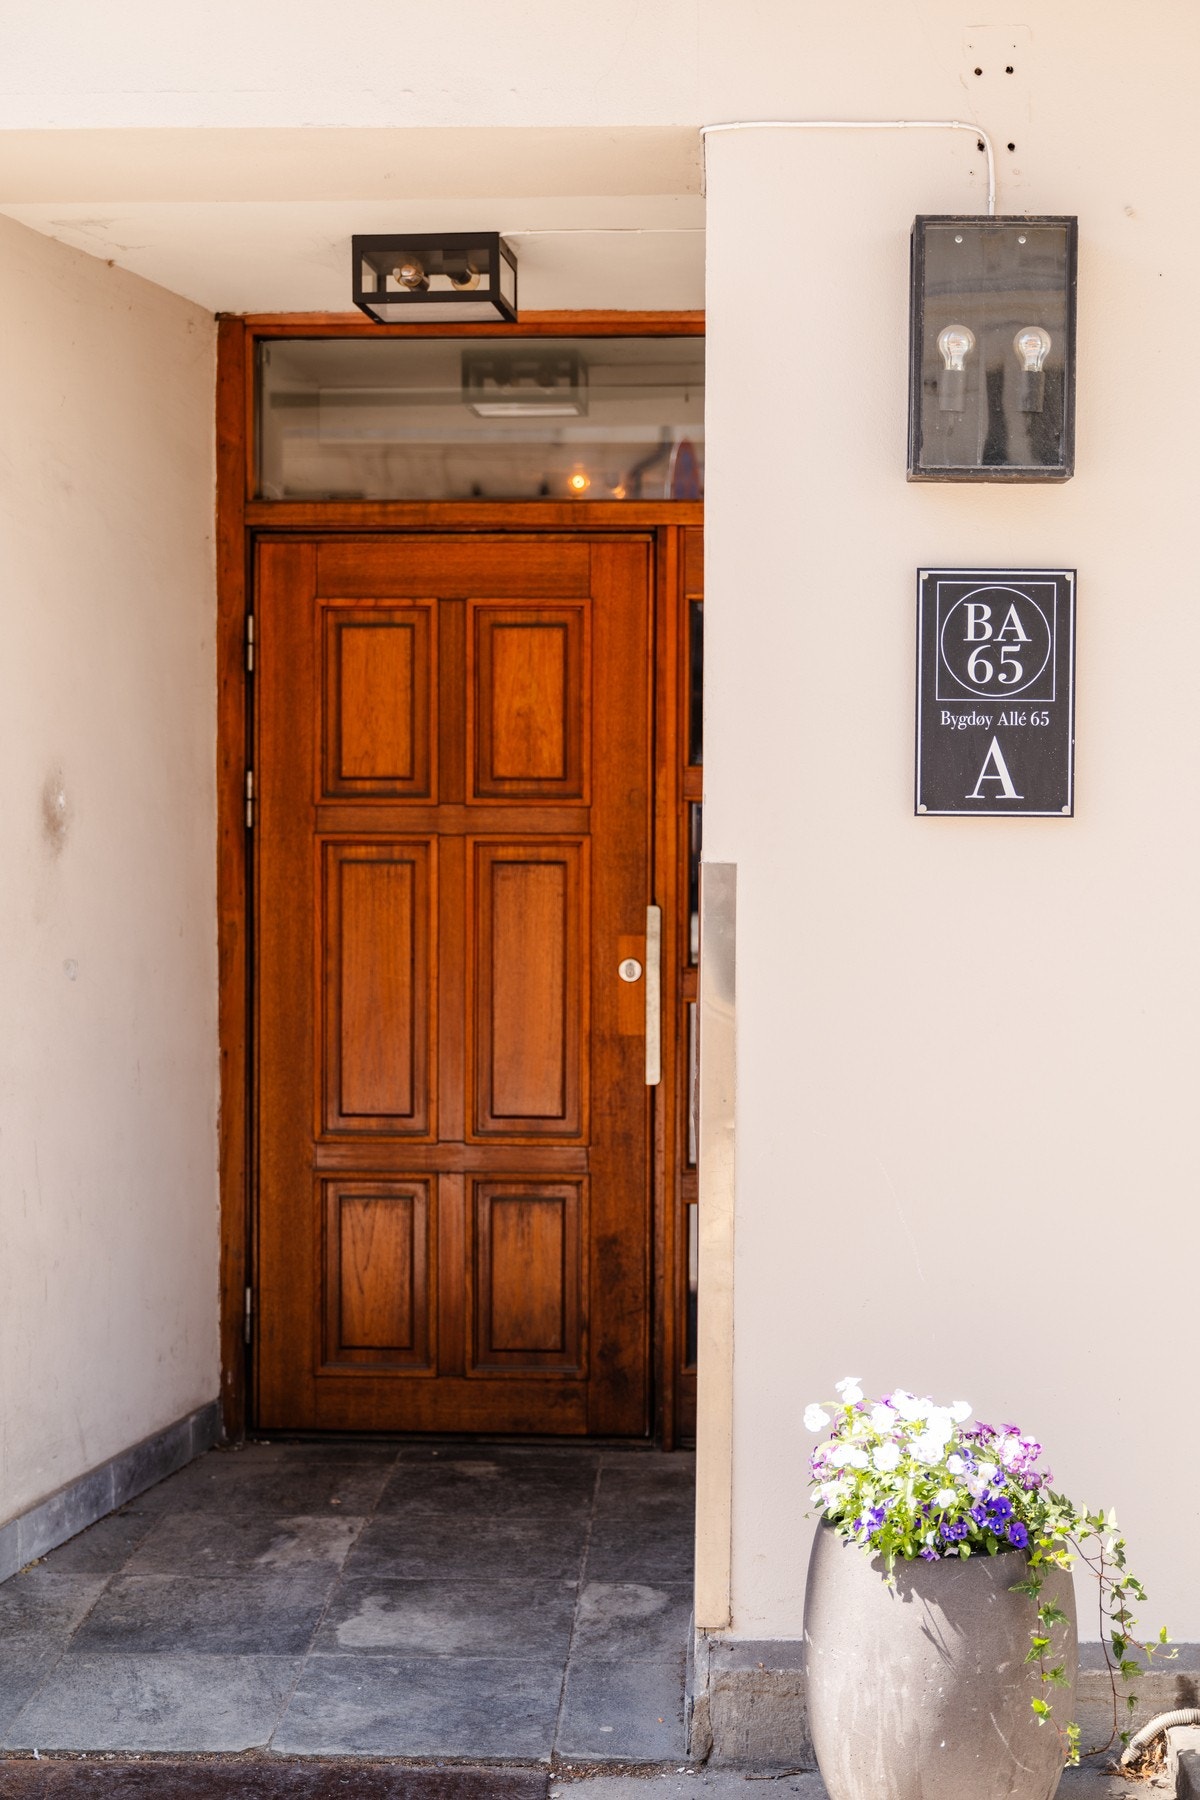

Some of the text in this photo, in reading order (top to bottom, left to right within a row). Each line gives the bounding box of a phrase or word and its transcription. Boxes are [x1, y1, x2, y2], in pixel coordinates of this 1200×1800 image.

[963, 603, 1032, 642] BA
[967, 644, 1024, 684] 65
[940, 710, 1050, 730] Bygdøy Allé 65
[965, 735, 1025, 799] A
